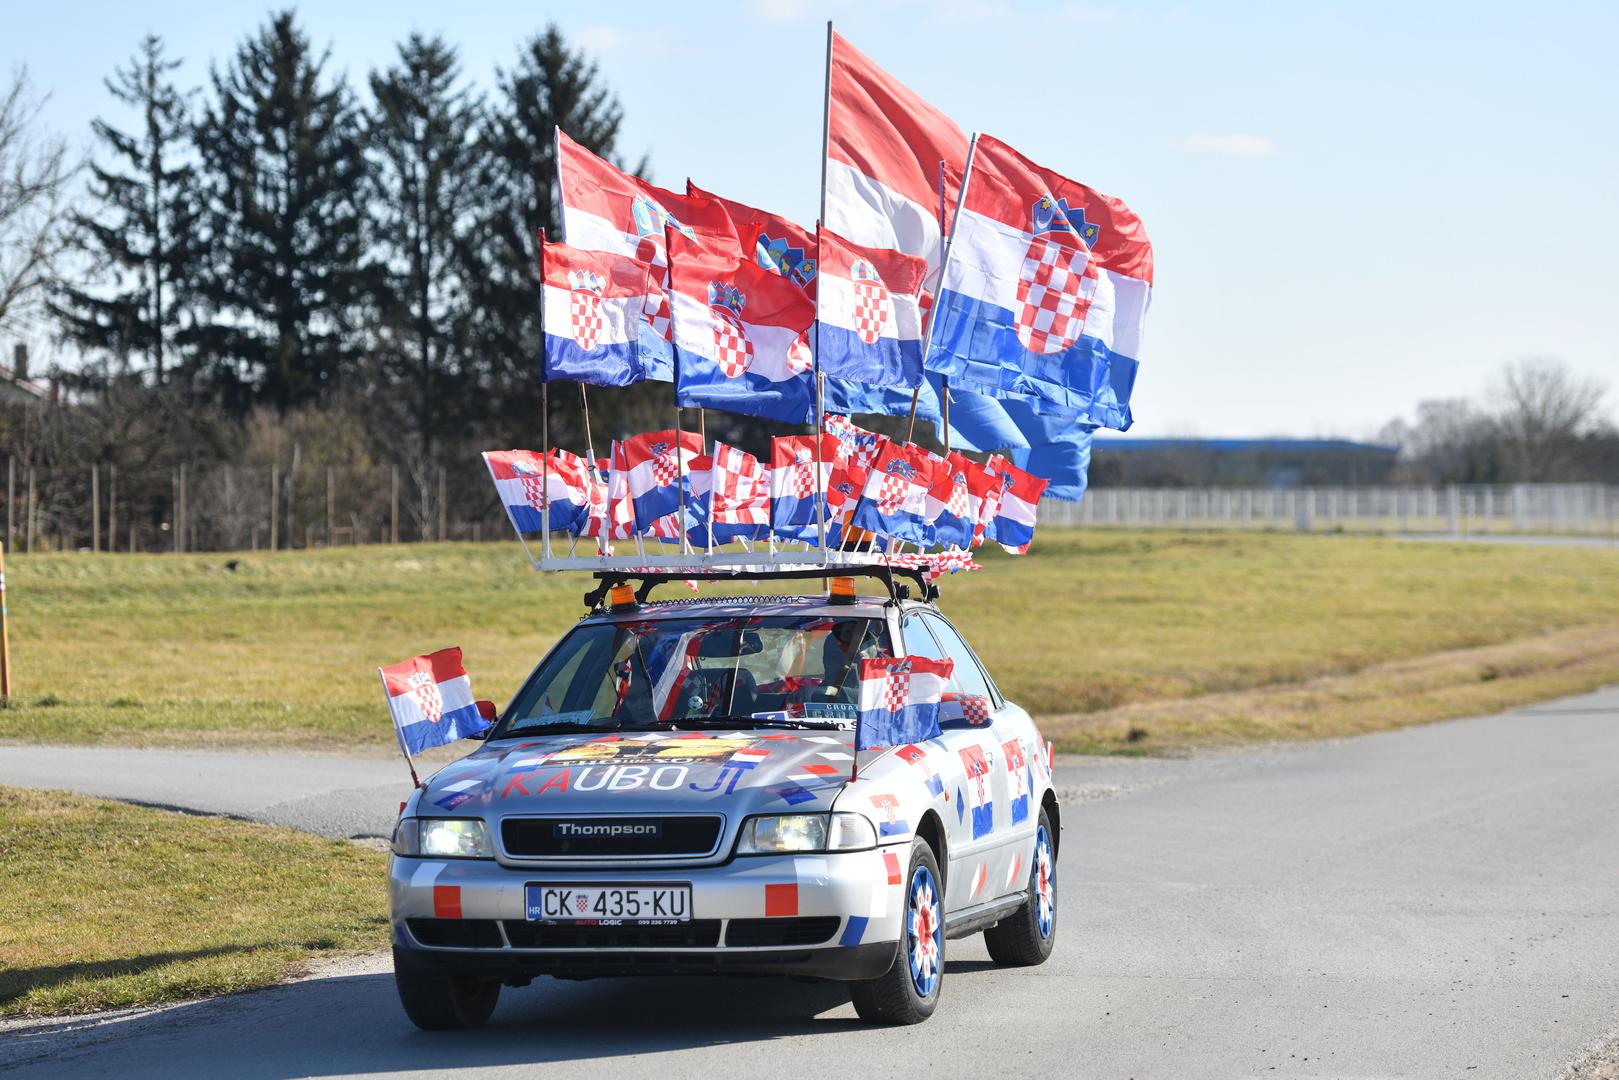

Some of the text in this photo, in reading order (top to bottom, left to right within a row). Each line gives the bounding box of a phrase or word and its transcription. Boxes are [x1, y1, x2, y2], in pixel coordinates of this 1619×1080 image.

[826, 703, 857, 711] CROA
[558, 823, 657, 836] Thompson
[593, 890, 685, 916] 435-KU
[528, 906, 541, 915] HR
